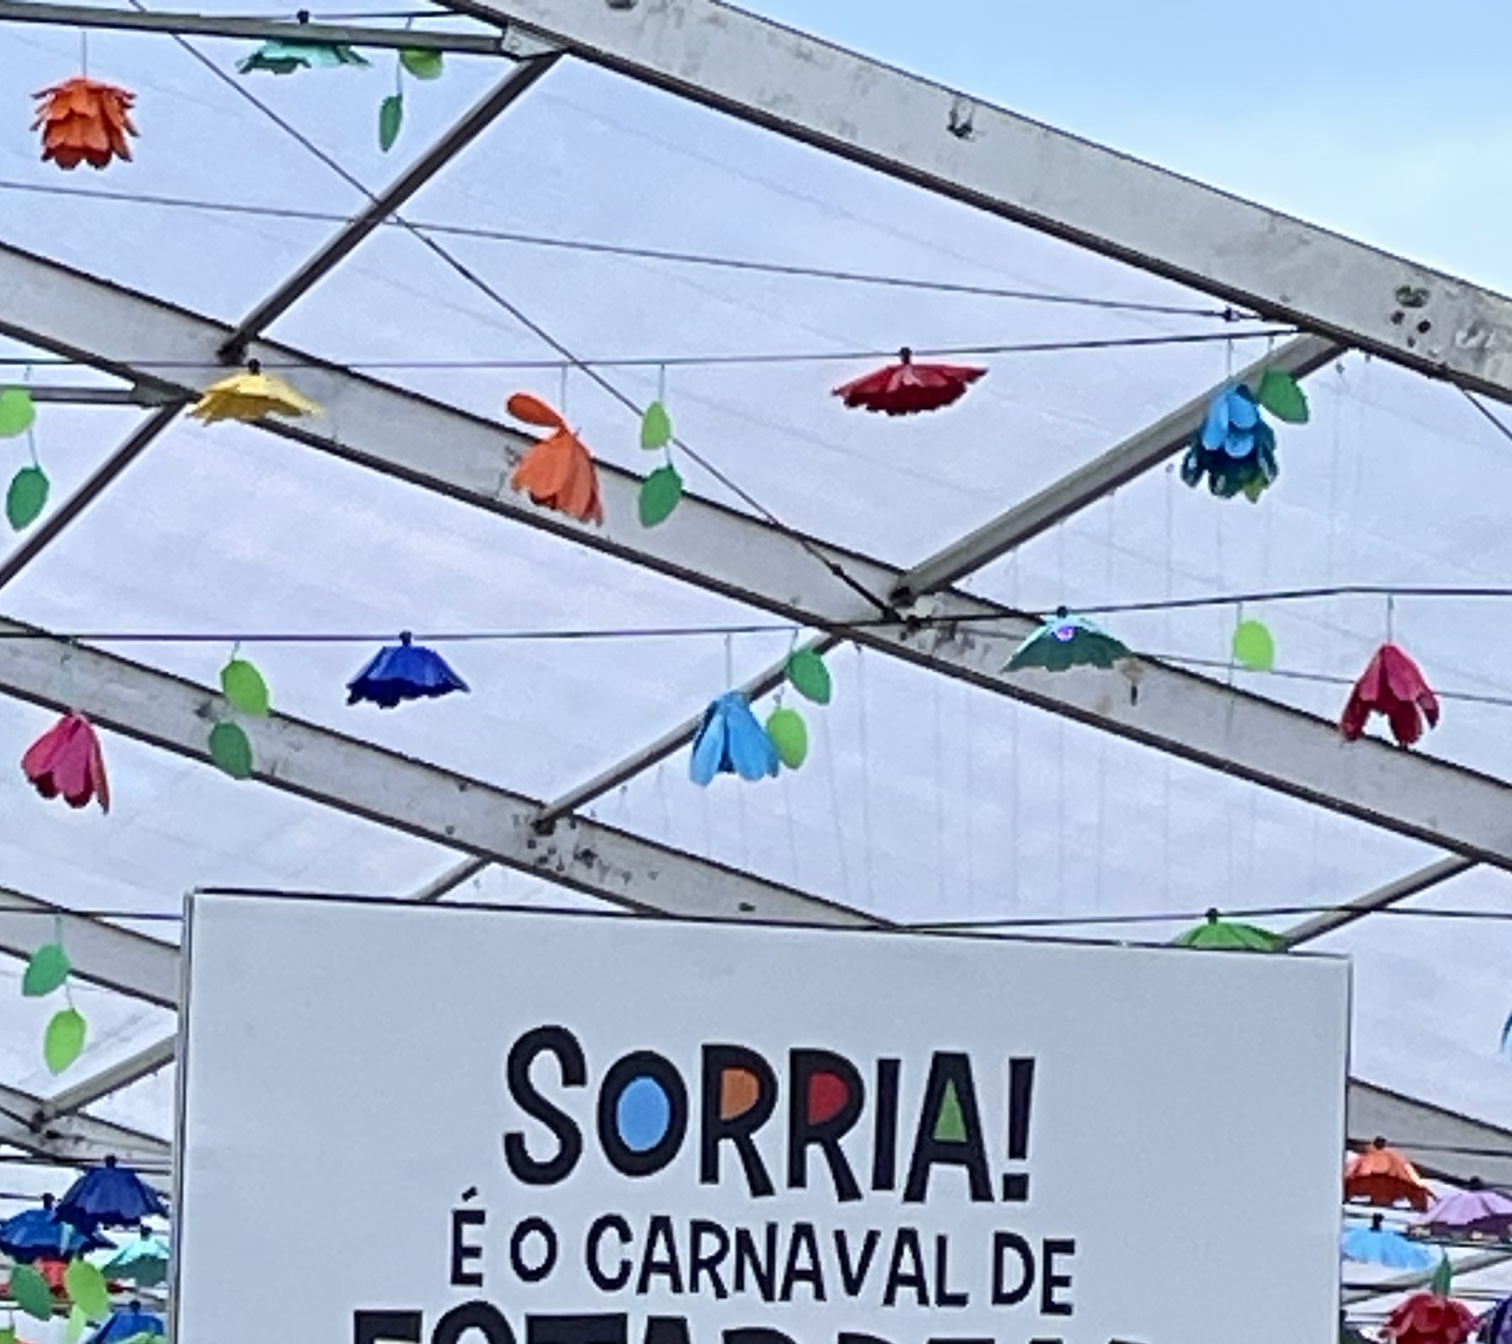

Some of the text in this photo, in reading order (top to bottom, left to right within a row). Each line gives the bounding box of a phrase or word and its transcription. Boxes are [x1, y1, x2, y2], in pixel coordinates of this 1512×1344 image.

[503, 1024, 1037, 1204] SORRIA!
[449, 1185, 1077, 1317] É O CARNAVAL DE
